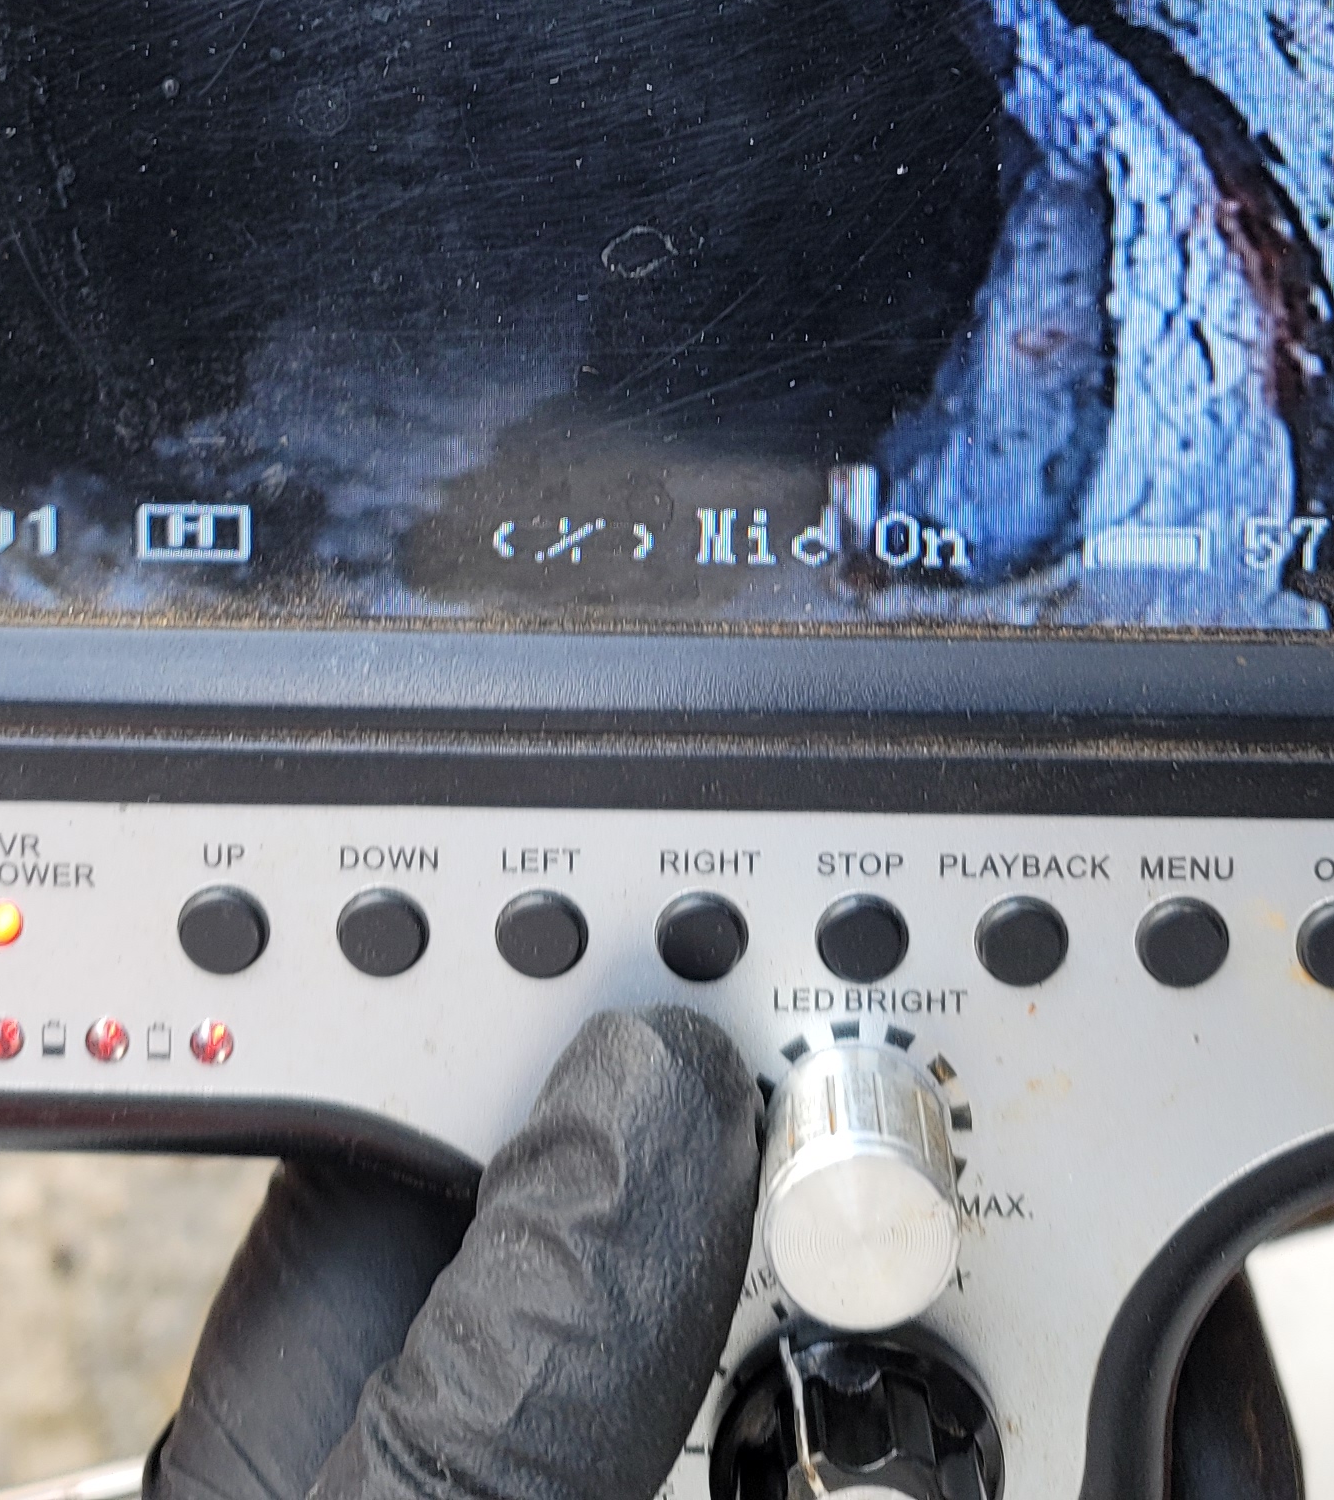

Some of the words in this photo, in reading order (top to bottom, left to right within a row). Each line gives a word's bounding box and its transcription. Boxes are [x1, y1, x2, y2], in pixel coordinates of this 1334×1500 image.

[873, 509, 971, 569] On
[202, 843, 246, 868] UP
[339, 846, 441, 871] DOWN
[501, 848, 581, 874] LEFT
[659, 850, 761, 876] RIGHT
[817, 851, 905, 877] STOP
[938, 853, 1111, 880] PLAYBACK
[1139, 855, 1235, 881] MENU
[772, 988, 835, 1013] LED
[844, 989, 968, 1016] BRIGHT
